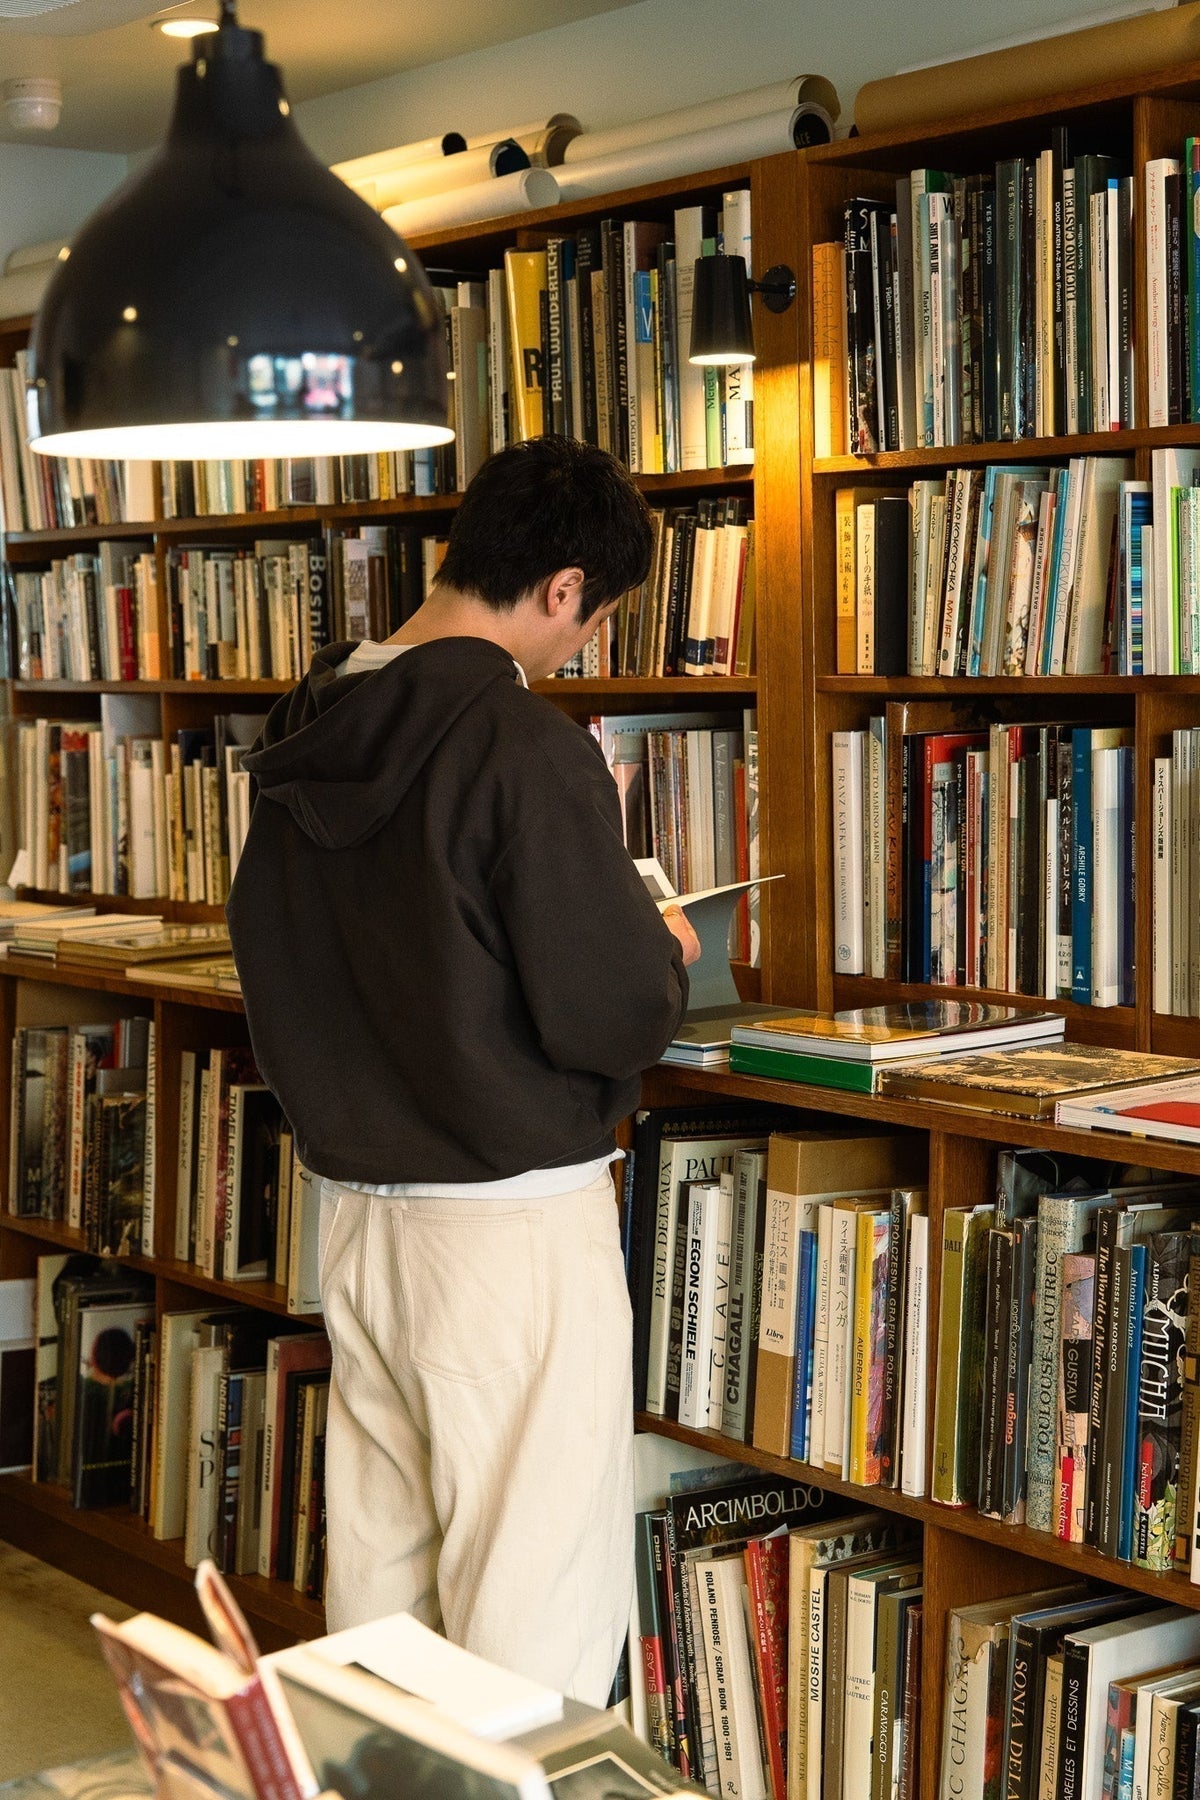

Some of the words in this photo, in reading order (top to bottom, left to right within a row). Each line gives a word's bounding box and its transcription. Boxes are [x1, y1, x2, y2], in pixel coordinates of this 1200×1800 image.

[929, 222, 939, 241] SHIT
[1064, 178, 1076, 242] CASTELLI
[929, 242, 939, 261] AND
[929, 261, 939, 276] DIE
[1065, 245, 1077, 302] LUCIANO
[547, 241, 562, 356] WUNDERLICH
[922, 291, 930, 314] Mark
[617, 320, 628, 352] JEAN
[923, 315, 931, 337] Dion
[550, 359, 564, 401] PAUL
[629, 418, 637, 466] WIFREDO
[954, 481, 965, 520] OSKAR
[947, 521, 961, 593] KOKOSCHKA
[1075, 530, 1087, 575] Photographic
[1054, 527, 1074, 626] STICKWORK
[309, 555, 327, 653] Bosnia
[945, 599, 954, 619] MY
[1070, 615, 1079, 638] Shahn
[944, 619, 953, 638] LIFE
[837, 768, 847, 807] FRANZ
[873, 776, 880, 789] TO
[887, 768, 899, 832] GUSTAV
[990, 772, 998, 808] GEORGES
[838, 811, 847, 851] KAFKA
[873, 791, 881, 829] MARINO
[990, 809, 998, 847] ROUAULT
[887, 835, 898, 897] KLIMT
[1077, 845, 1086, 876] ARSHILE
[840, 874, 848, 922] DRAWINGS
[1077, 877, 1086, 903] GORKY
[226, 1092, 238, 1178] TIMELESS
[224, 1181, 235, 1242] TIARAS
[657, 1159, 672, 1247] DELVAUX
[673, 1222, 688, 1299] Nicolas
[689, 1237, 702, 1289] EGON
[944, 1239, 962, 1253] DALI
[1098, 1246, 1111, 1271] The
[655, 1250, 668, 1299] PAUL
[1097, 1271, 1110, 1315] World
[1112, 1261, 1122, 1304] MATISSE
[1129, 1267, 1139, 1313] Antonio
[671, 1305, 684, 1331] de
[685, 1290, 701, 1361] SCHIELE
[765, 1327, 785, 1342] Libro
[857, 1296, 868, 1335] FRANK
[886, 1298, 900, 1354] GRAFIKA
[1095, 1316, 1107, 1335] of
[1127, 1314, 1137, 1350] López
[726, 1292, 745, 1406] CHAGALL
[1036, 1250, 1058, 1458] TOULOUSE-LAUTREC
[1094, 1335, 1106, 1370] Marc
[1109, 1321, 1119, 1372] MOROCCO
[1190, 1326, 1200, 1356] zum
[855, 1336, 867, 1397] AUERBACH
[885, 1354, 897, 1401] POLSKA
[1065, 1347, 1081, 1406] GUSTAV
[1138, 1314, 1171, 1421] MUCHA
[219, 1376, 229, 1432] NDEBELE
[1005, 1391, 1017, 1446] Gauguin
[1090, 1371, 1104, 1429] Chagall
[1180, 1391, 1196, 1497] Glockenspiel
[684, 1485, 825, 1532] ARCIMBOLDO
[1138, 1461, 1152, 1510] belvedere
[1059, 1481, 1073, 1537] belvedere
[1178, 1504, 1189, 1531] Vom
[665, 1509, 678, 1568] ARCIMBOLDO
[1139, 1523, 1148, 1550] PRESTEL
[673, 1591, 685, 1630] WERNER
[704, 1570, 716, 1605] ROLAND
[709, 1607, 721, 1647] PENROSE
[810, 1587, 822, 1641] CASTEL
[645, 1643, 658, 1692] SILAS?
[714, 1655, 725, 1684] SCRAP
[809, 1644, 822, 1704] MOSHE
[847, 1674, 872, 1686] LAUTREC
[718, 1687, 728, 1711] BOOK
[846, 1689, 871, 1702] LAUTREC
[1011, 1657, 1028, 1728] SONIA
[1067, 1678, 1080, 1731] DESSINS
[721, 1715, 733, 1762] 1900-1981
[878, 1689, 890, 1763] CARAVAGGIO
[1044, 1693, 1058, 1785] Zahnheilkunde
[1065, 1736, 1077, 1753] ET
